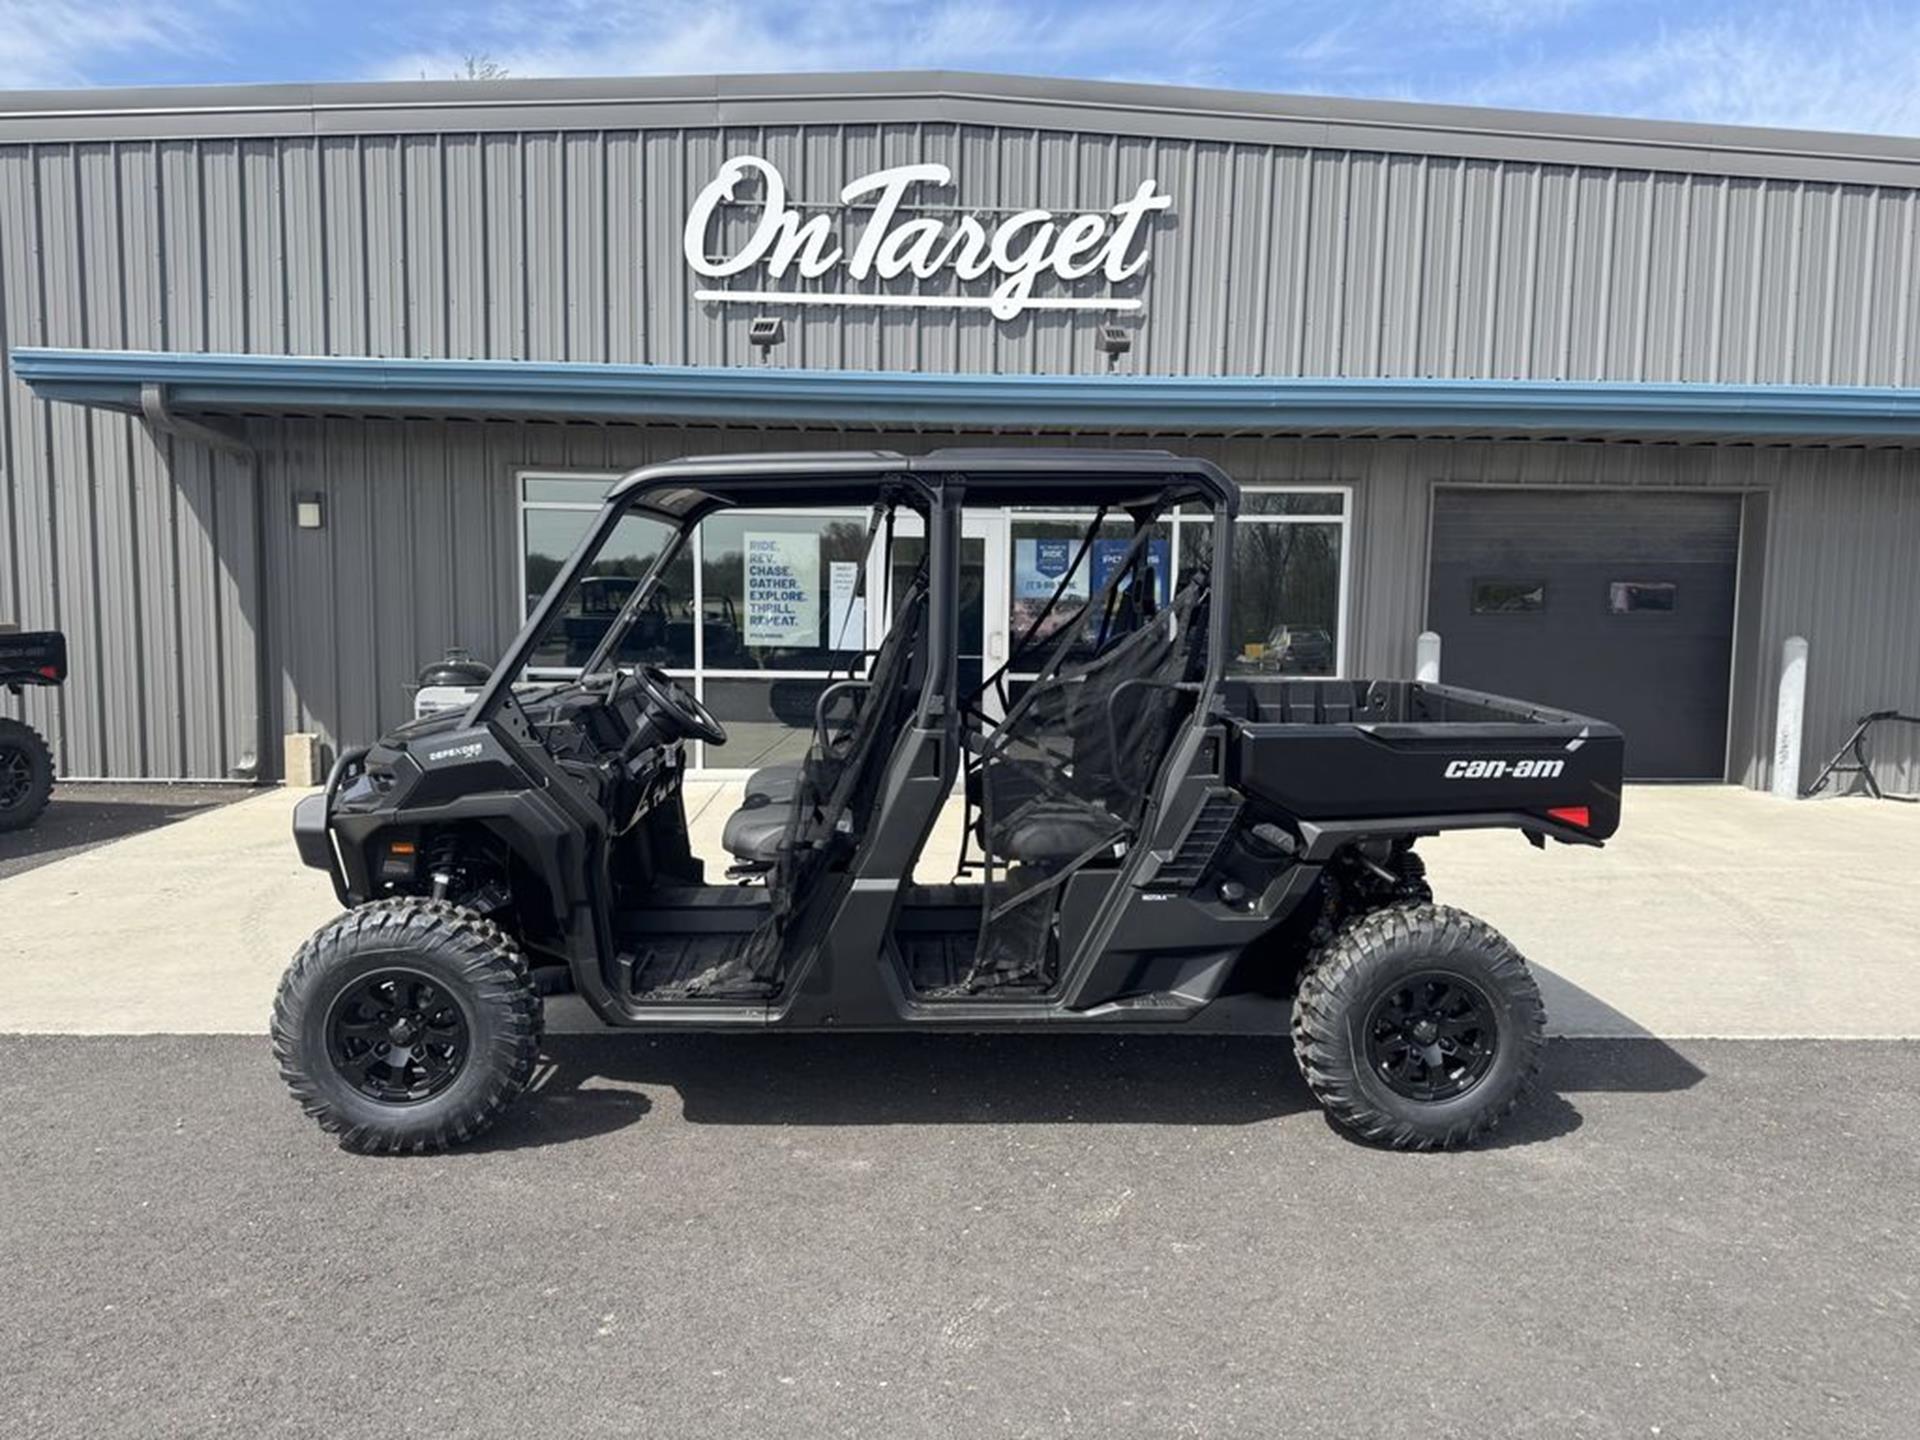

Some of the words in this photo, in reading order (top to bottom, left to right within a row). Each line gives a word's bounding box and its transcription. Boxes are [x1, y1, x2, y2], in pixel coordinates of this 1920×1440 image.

[684, 155, 842, 278] On
[840, 163, 1172, 321] Target
[749, 565, 794, 577] CHASE.
[749, 578, 799, 589] GATHER.
[749, 590, 808, 602] EXPLORE.
[750, 603, 796, 614] THRILL.
[749, 615, 798, 627] REPEAT.
[429, 743, 482, 760] DEFENDER
[1444, 760, 1565, 778] can-am
